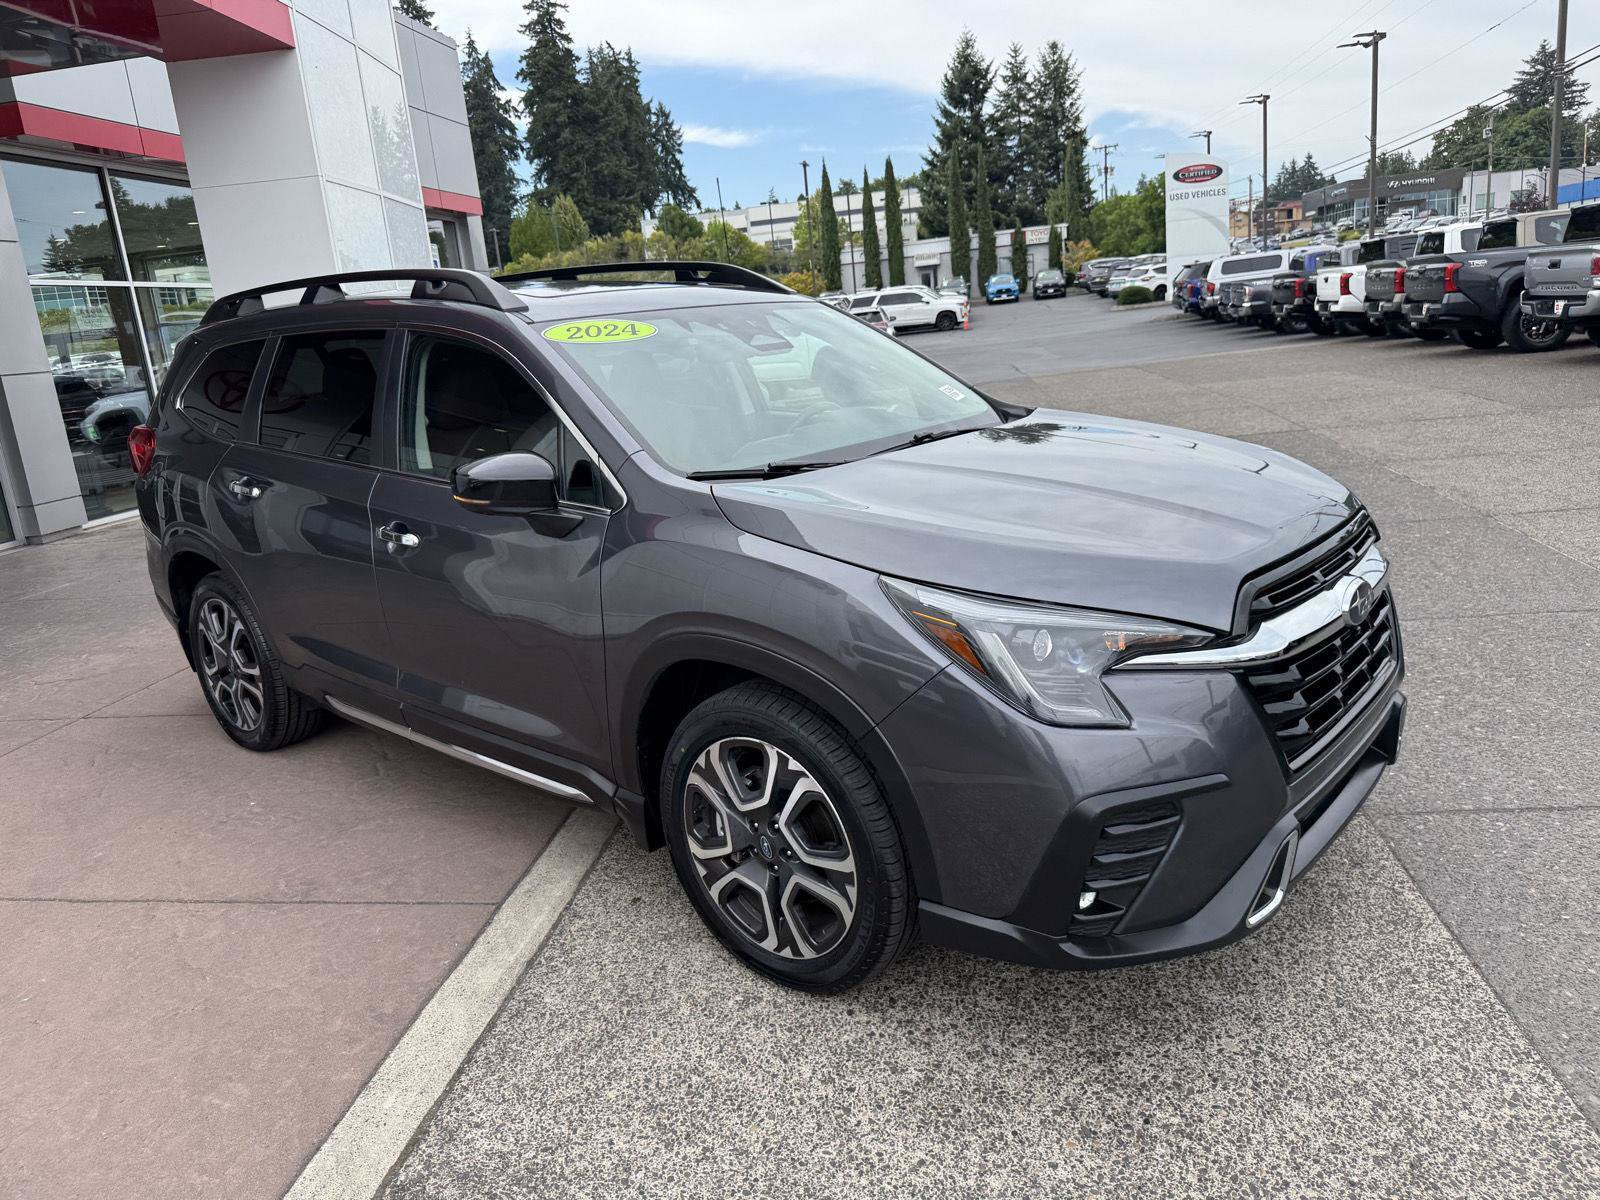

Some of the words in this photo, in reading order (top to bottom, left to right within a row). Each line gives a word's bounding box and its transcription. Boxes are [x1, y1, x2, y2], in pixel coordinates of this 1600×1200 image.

[1179, 169, 1217, 178] CERTIFIED
[1402, 177, 1435, 185] HYUNDAI
[1170, 192, 1190, 201] USED
[1191, 188, 1226, 199] VEHICLES
[1031, 228, 1049, 236] TOYO
[566, 323, 640, 340] 2024
